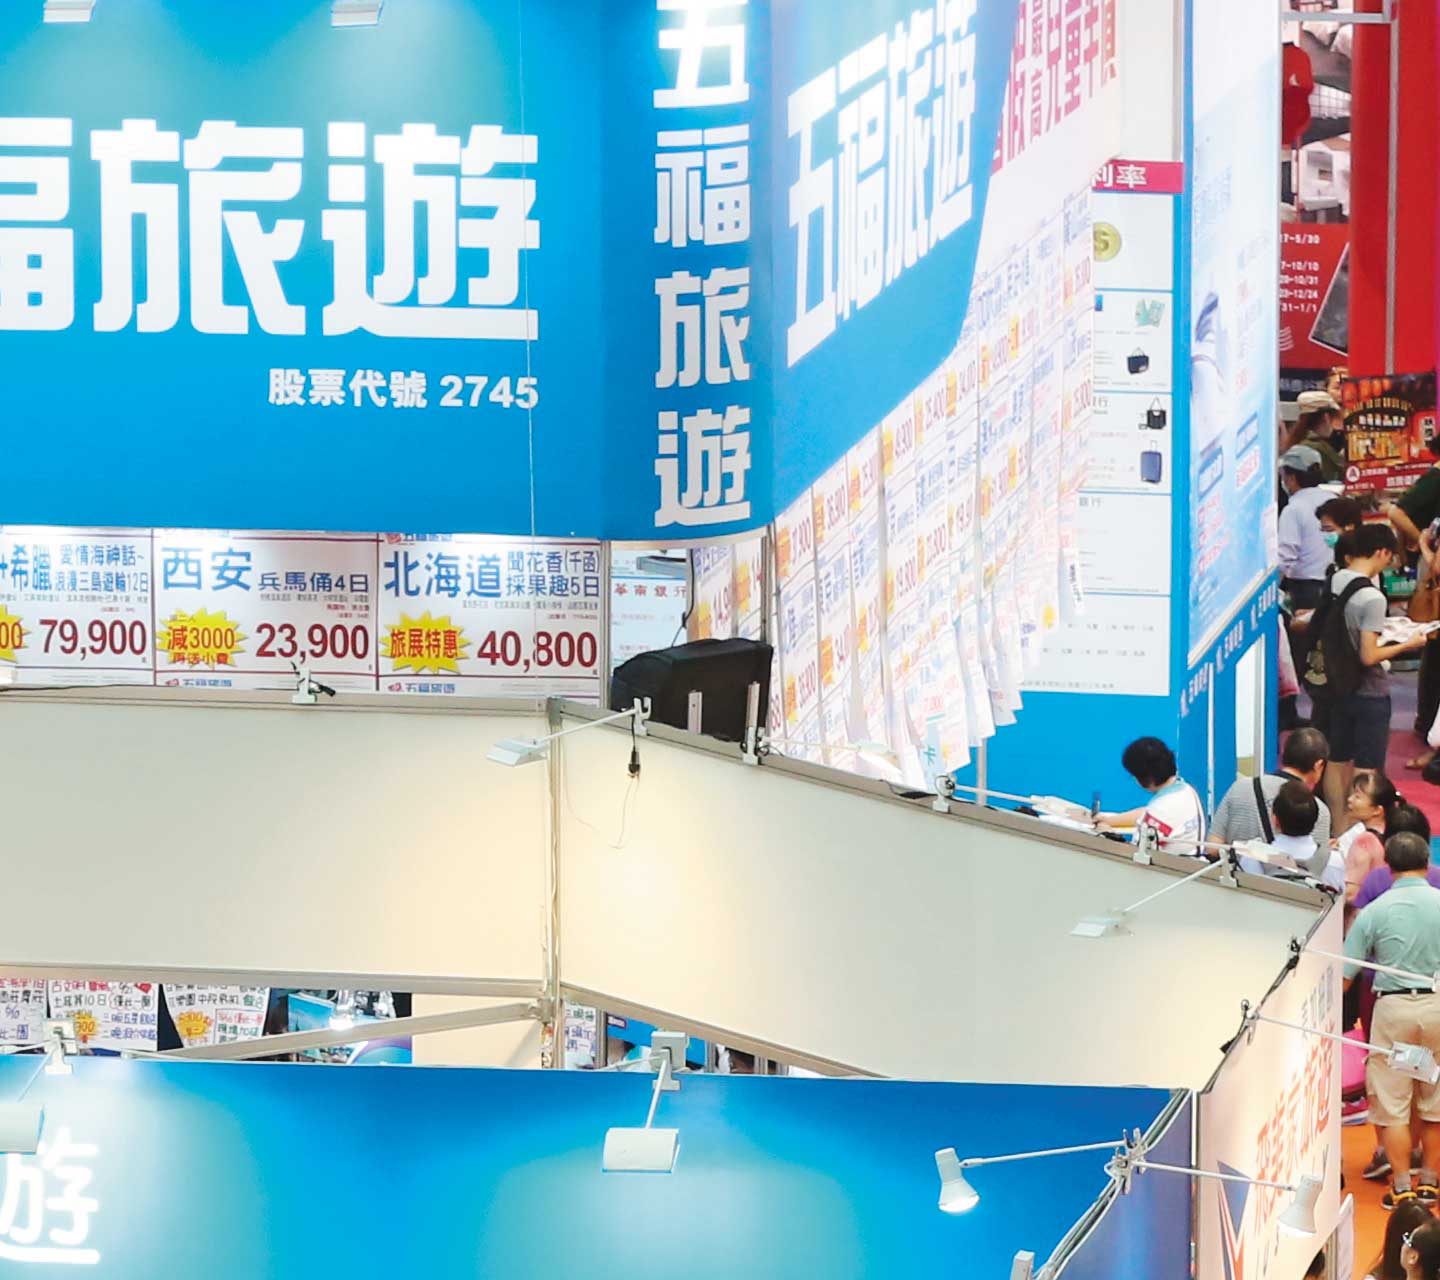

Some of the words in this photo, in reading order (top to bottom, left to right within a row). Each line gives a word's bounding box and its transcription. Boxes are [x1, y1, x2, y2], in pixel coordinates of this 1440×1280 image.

[267, 366, 427, 411] 股票代號
[439, 372, 541, 412] 2745
[161, 545, 252, 591] 西安
[258, 572, 369, 594] 兵馬俑4日
[382, 547, 501, 599] 北海道
[39, 618, 148, 657] 79,900
[254, 622, 370, 663] 23,900
[390, 627, 458, 659] 旅展特惠
[476, 629, 599, 669] 40,800
